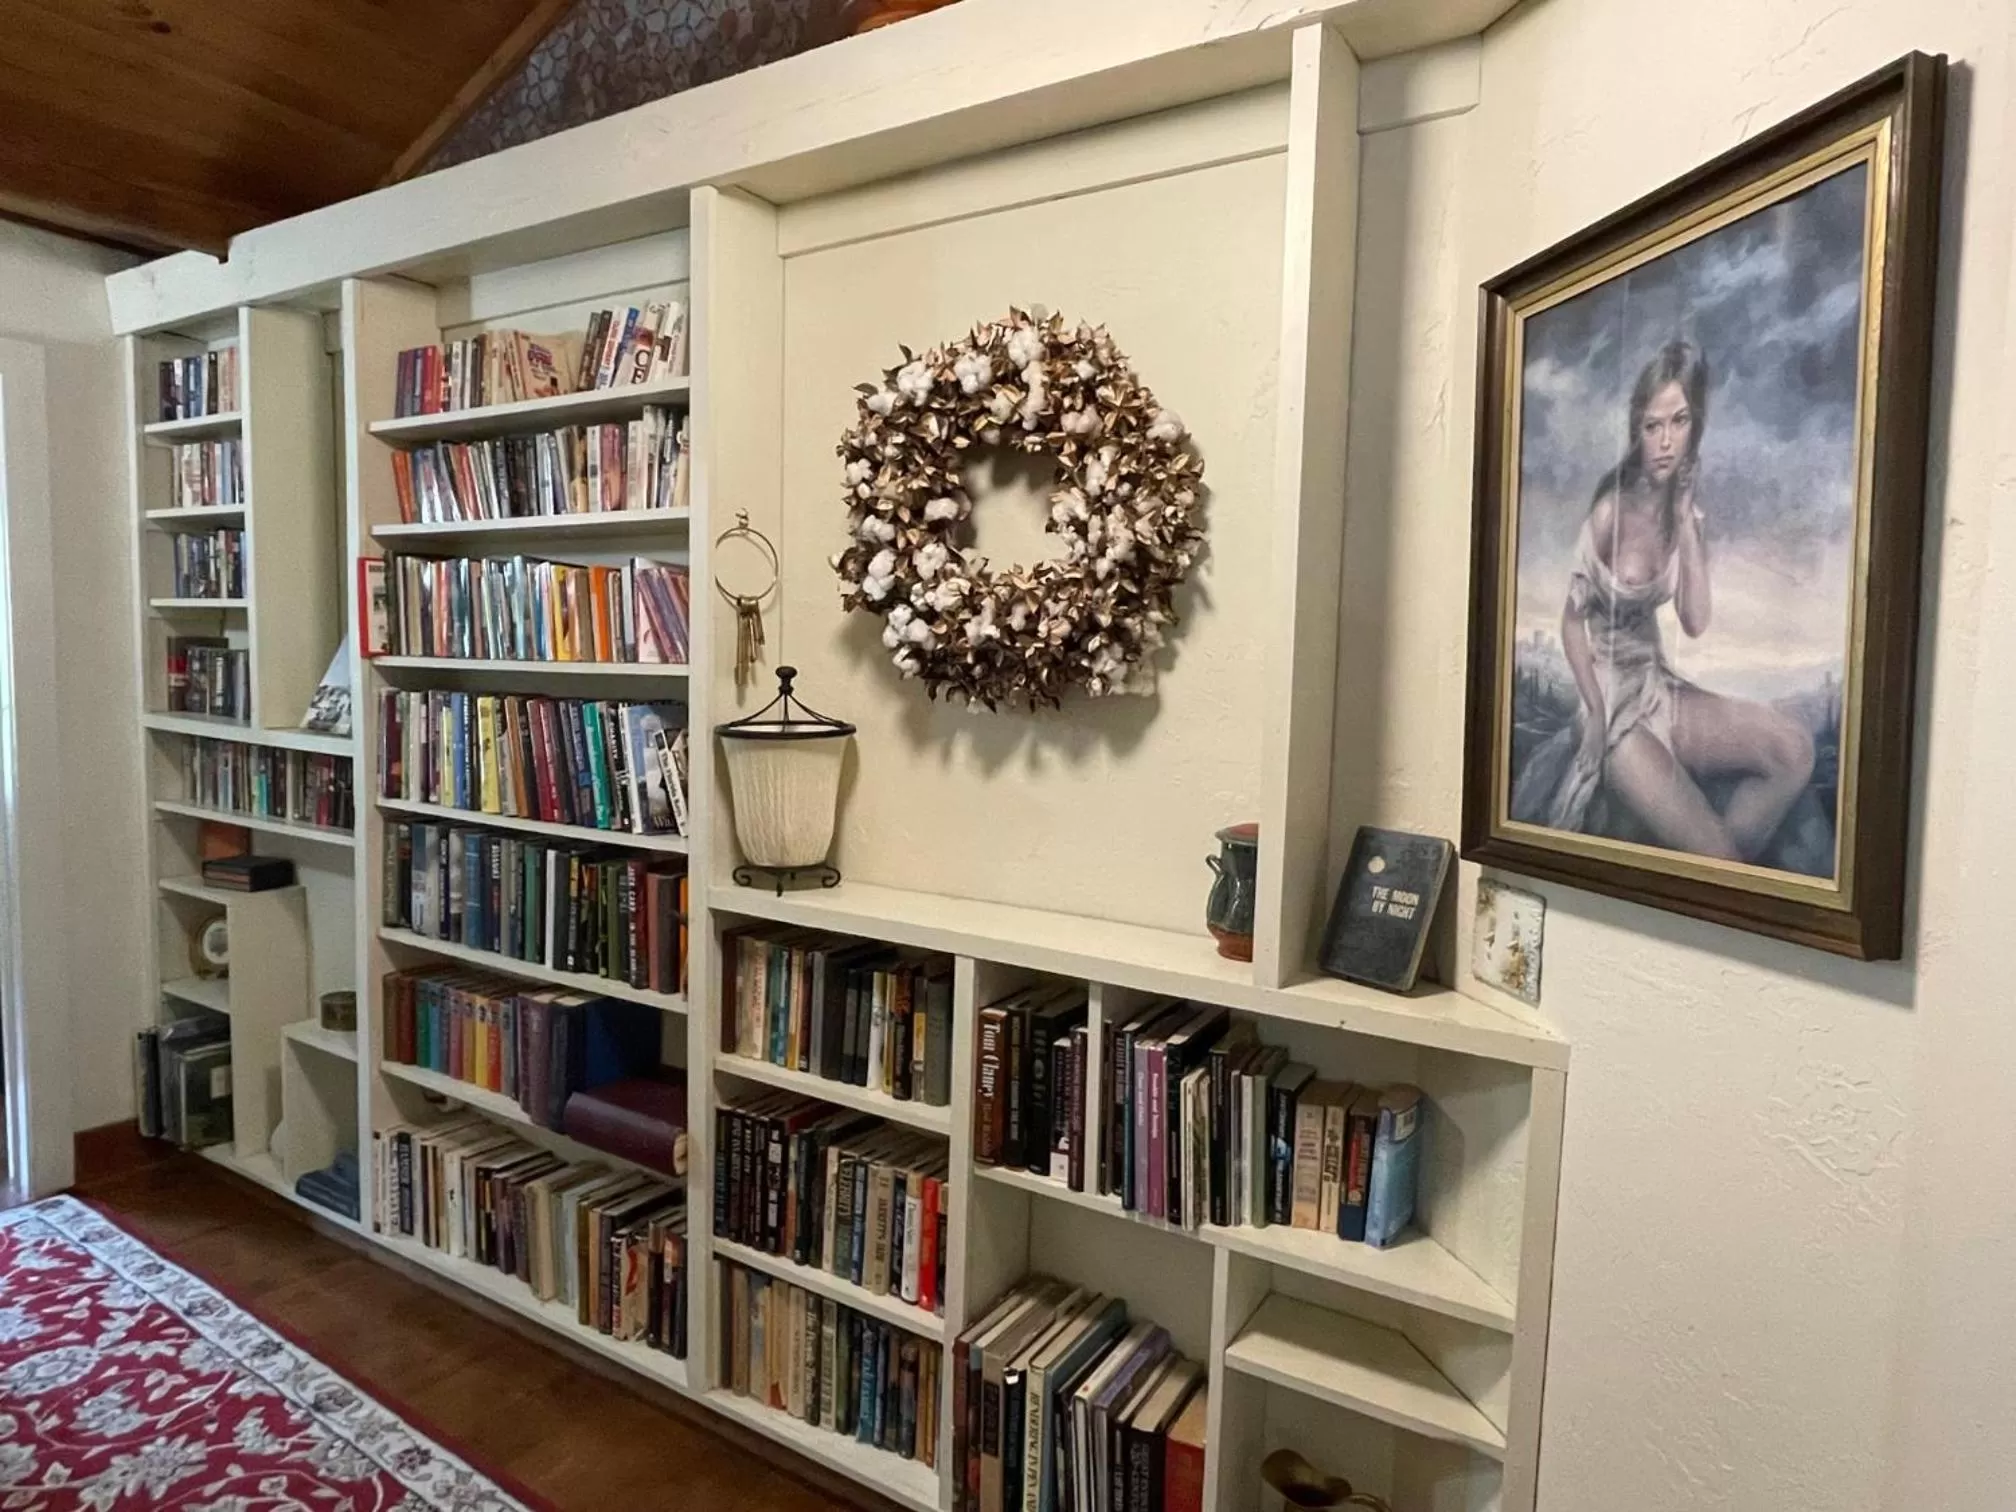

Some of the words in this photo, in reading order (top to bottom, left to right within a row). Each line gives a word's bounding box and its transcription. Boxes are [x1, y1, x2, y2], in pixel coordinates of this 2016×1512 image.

[1372, 886, 1390, 900] THE
[1391, 889, 1420, 906] MOON
[1371, 900, 1387, 913] BY
[1387, 903, 1415, 920] NIGHT
[983, 1022, 1001, 1052] Tom
[978, 1054, 1000, 1098] Clancy
